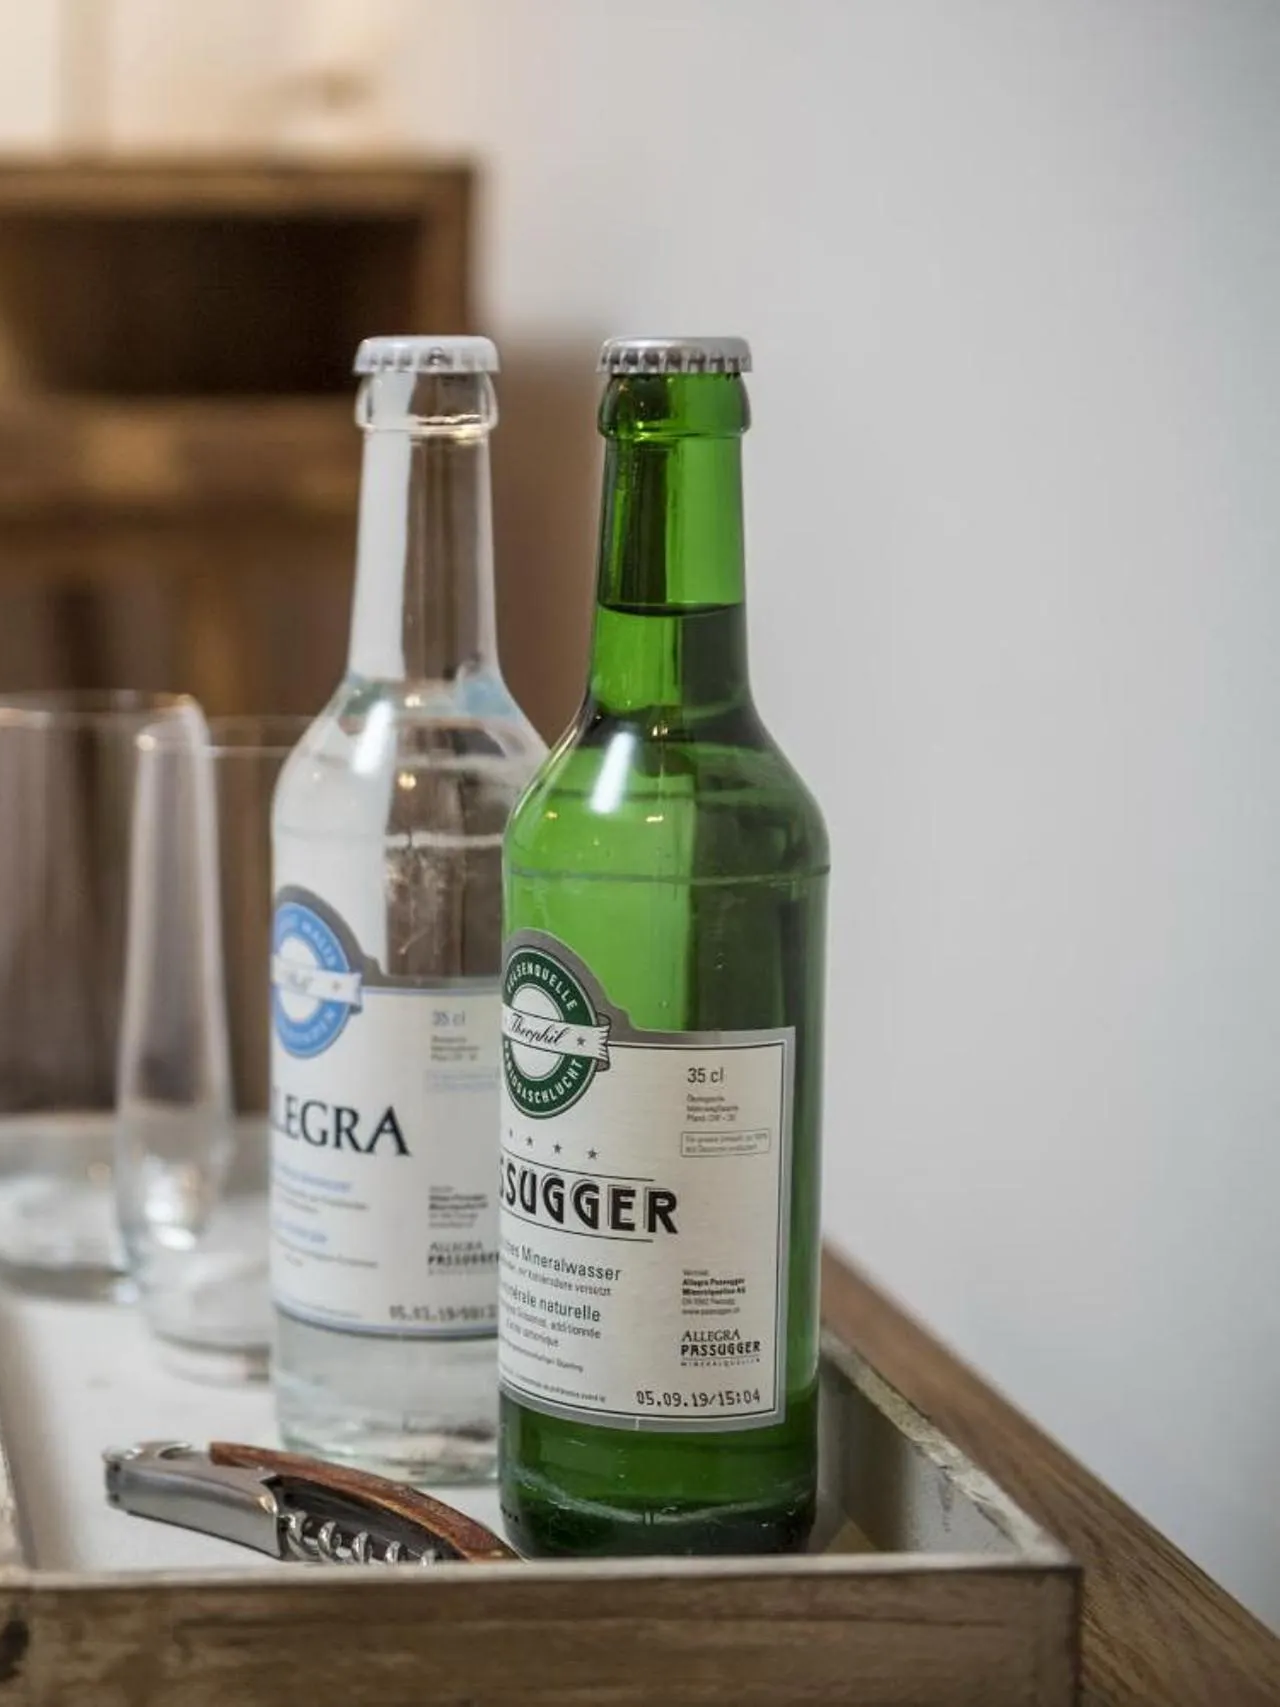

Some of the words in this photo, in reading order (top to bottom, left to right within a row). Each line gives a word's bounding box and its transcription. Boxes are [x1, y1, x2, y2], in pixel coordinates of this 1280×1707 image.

[687, 1066, 706, 1083] 35
[710, 1066, 724, 1083] cl
[521, 1244, 623, 1281] Mineralwasser
[539, 1296, 602, 1322] naturelle
[681, 1327, 742, 1342] ALLEGRA
[680, 1340, 762, 1357] PASSUGGER
[635, 1387, 761, 1408] 05.09.19/15:04
